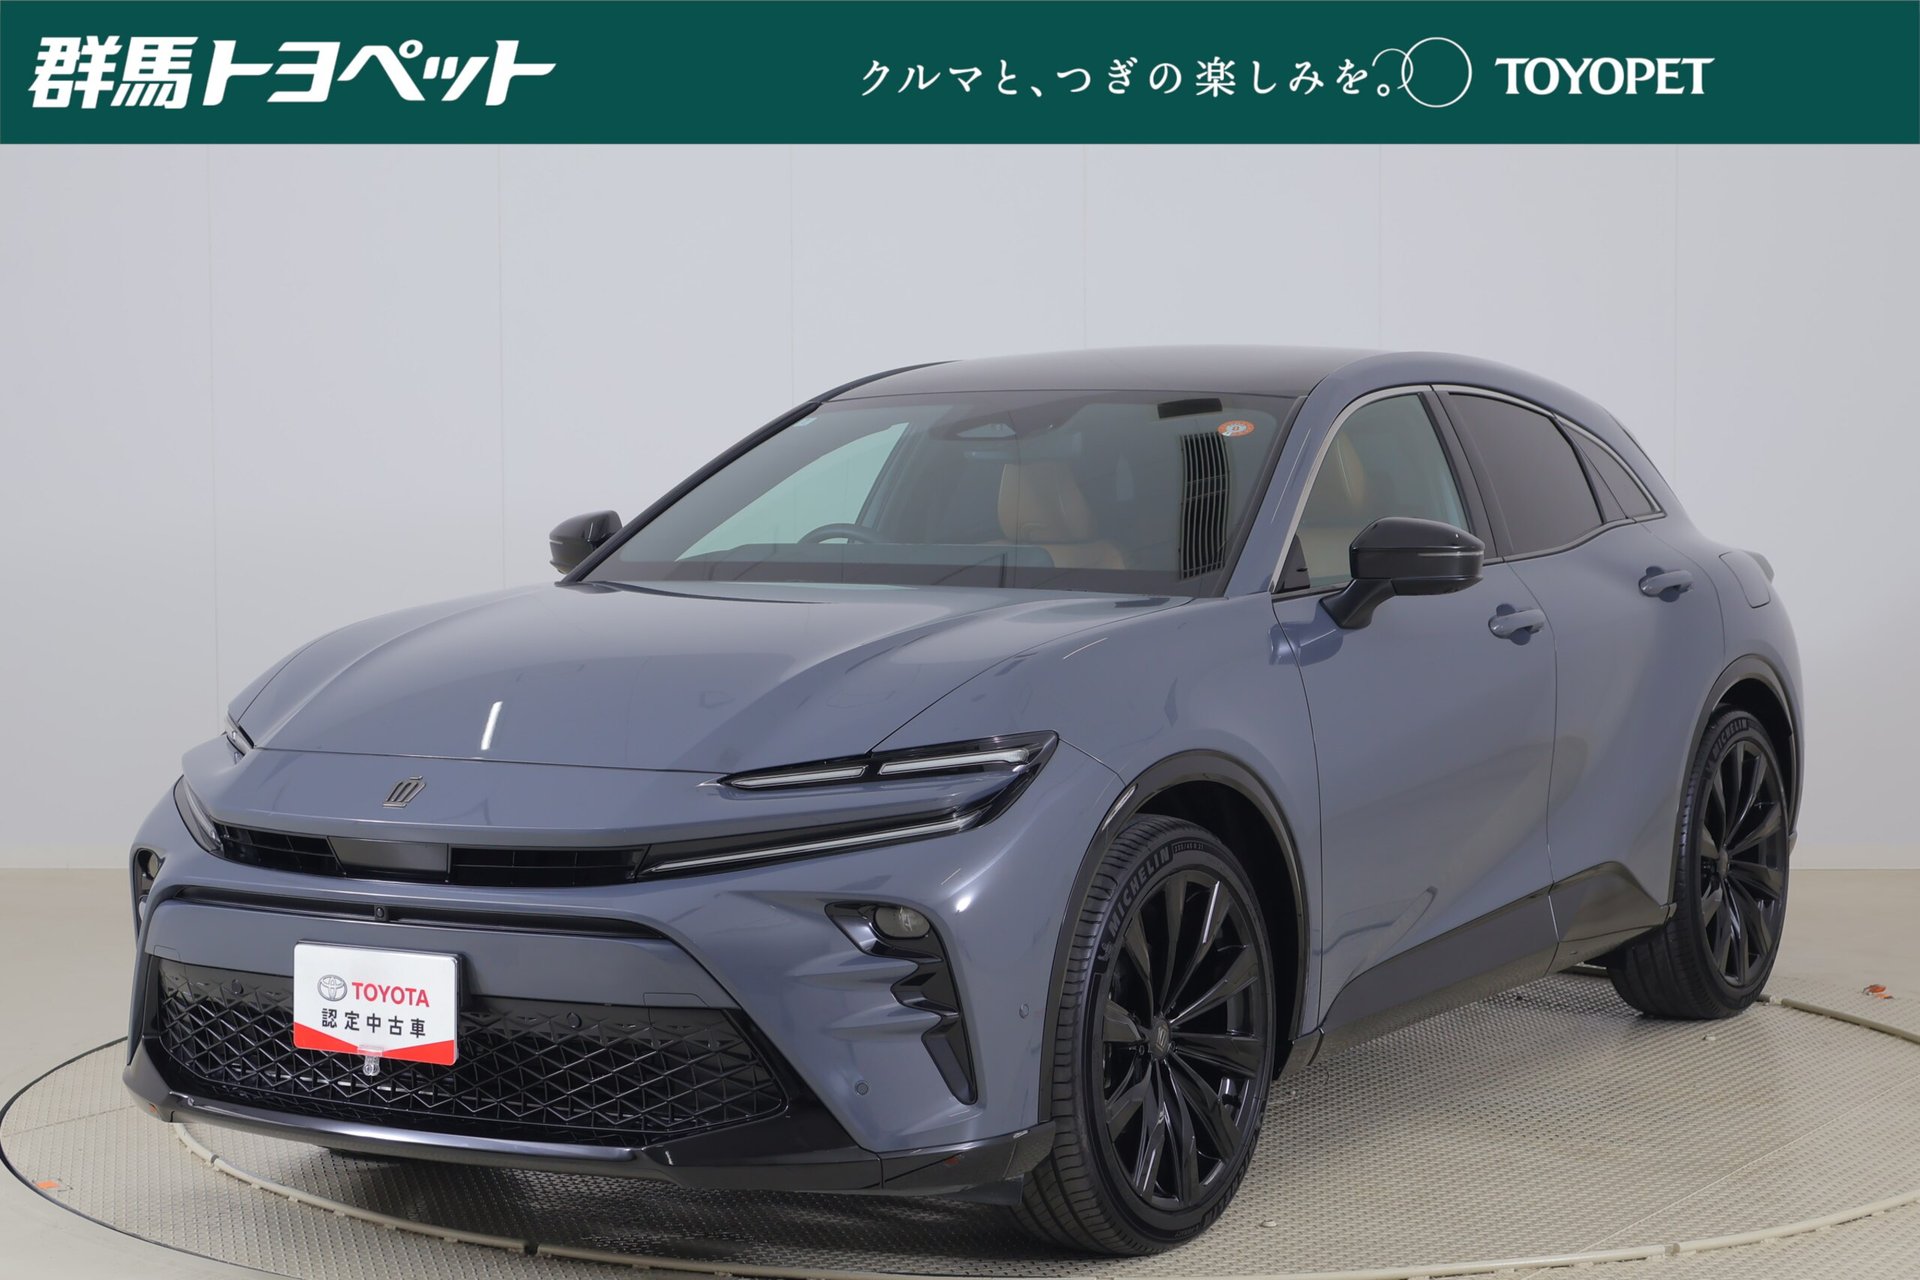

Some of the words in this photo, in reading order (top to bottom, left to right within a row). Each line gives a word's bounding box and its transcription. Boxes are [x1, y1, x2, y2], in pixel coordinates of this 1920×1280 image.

[1108, 846, 1170, 938] MICHELIN
[352, 982, 430, 1008] TOYOTA
[321, 1007, 427, 1039] 認定中古車
